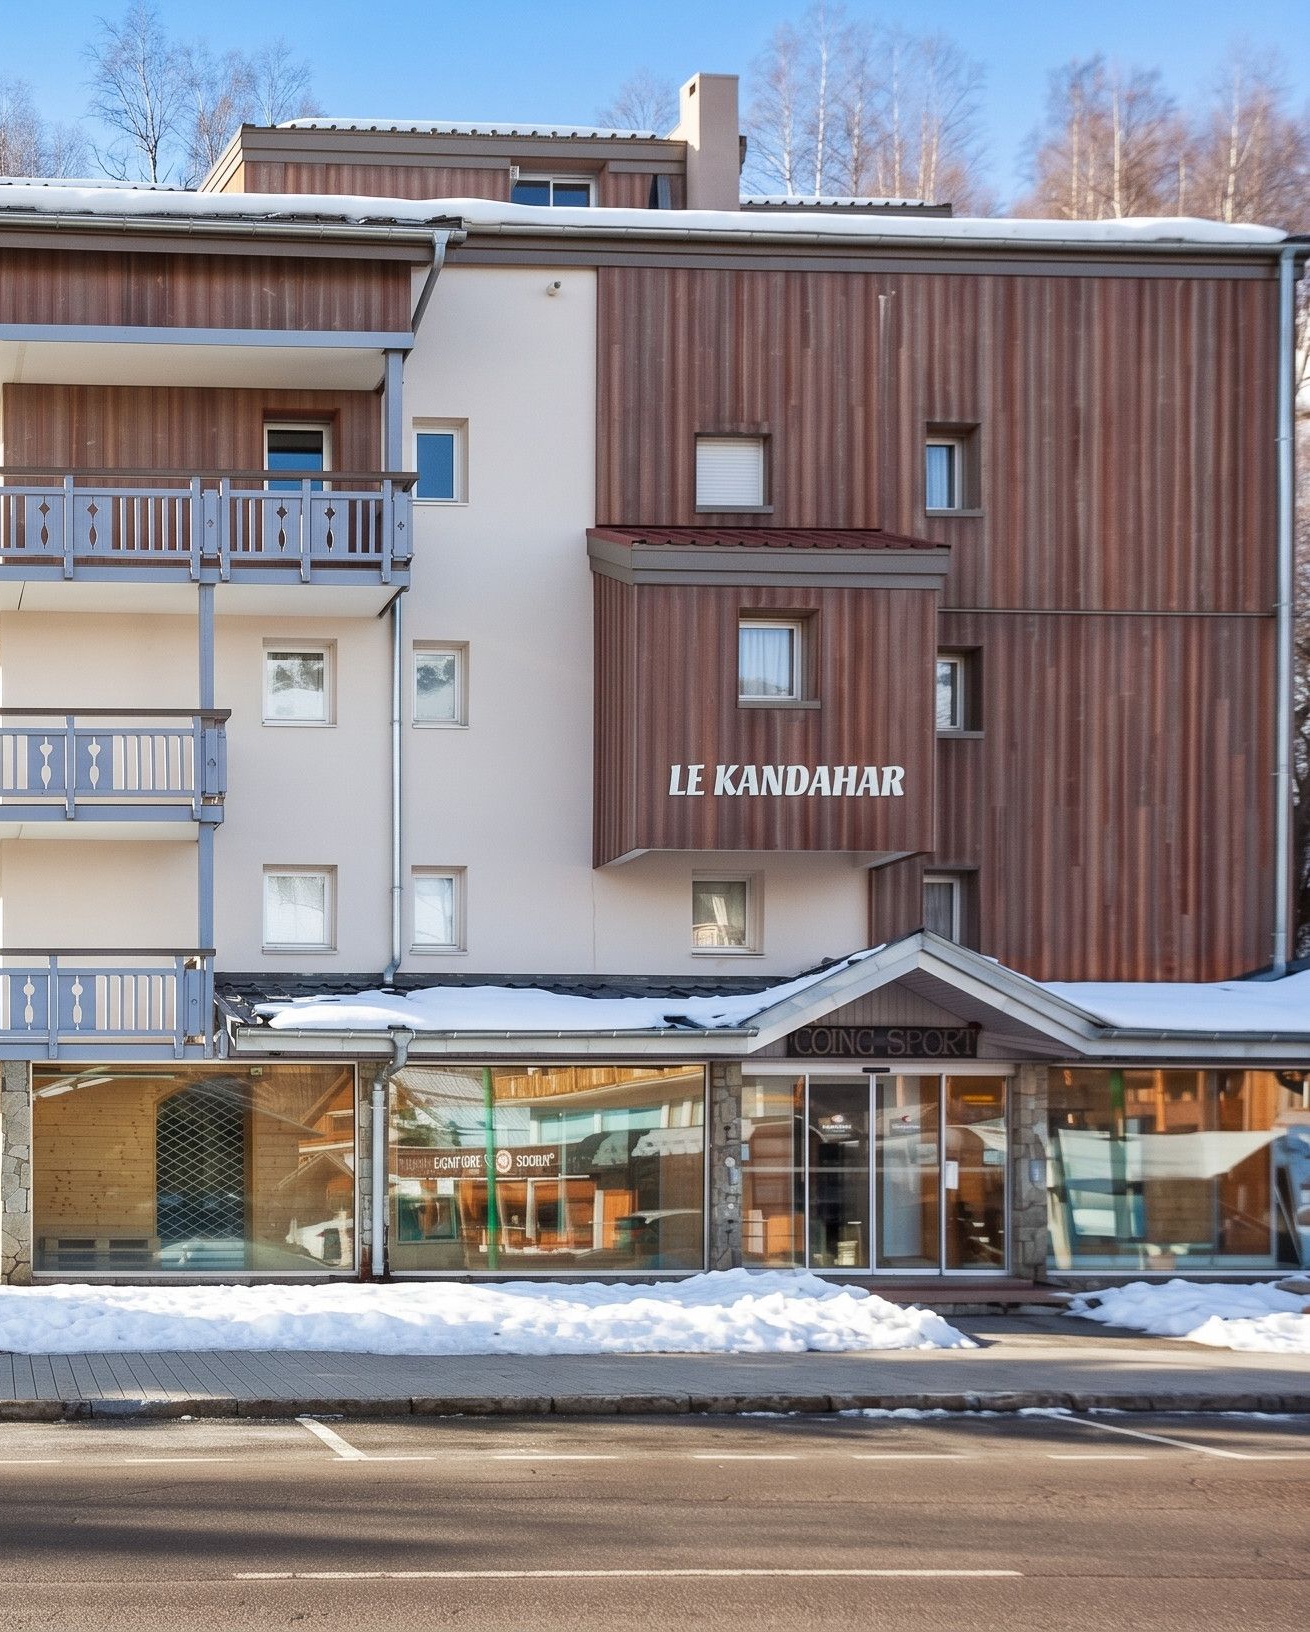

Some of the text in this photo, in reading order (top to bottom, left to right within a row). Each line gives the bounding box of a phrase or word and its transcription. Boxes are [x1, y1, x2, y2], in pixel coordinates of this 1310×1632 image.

[668, 764, 906, 797] LE KANDAHAR
[887, 1028, 977, 1057] SPORT
